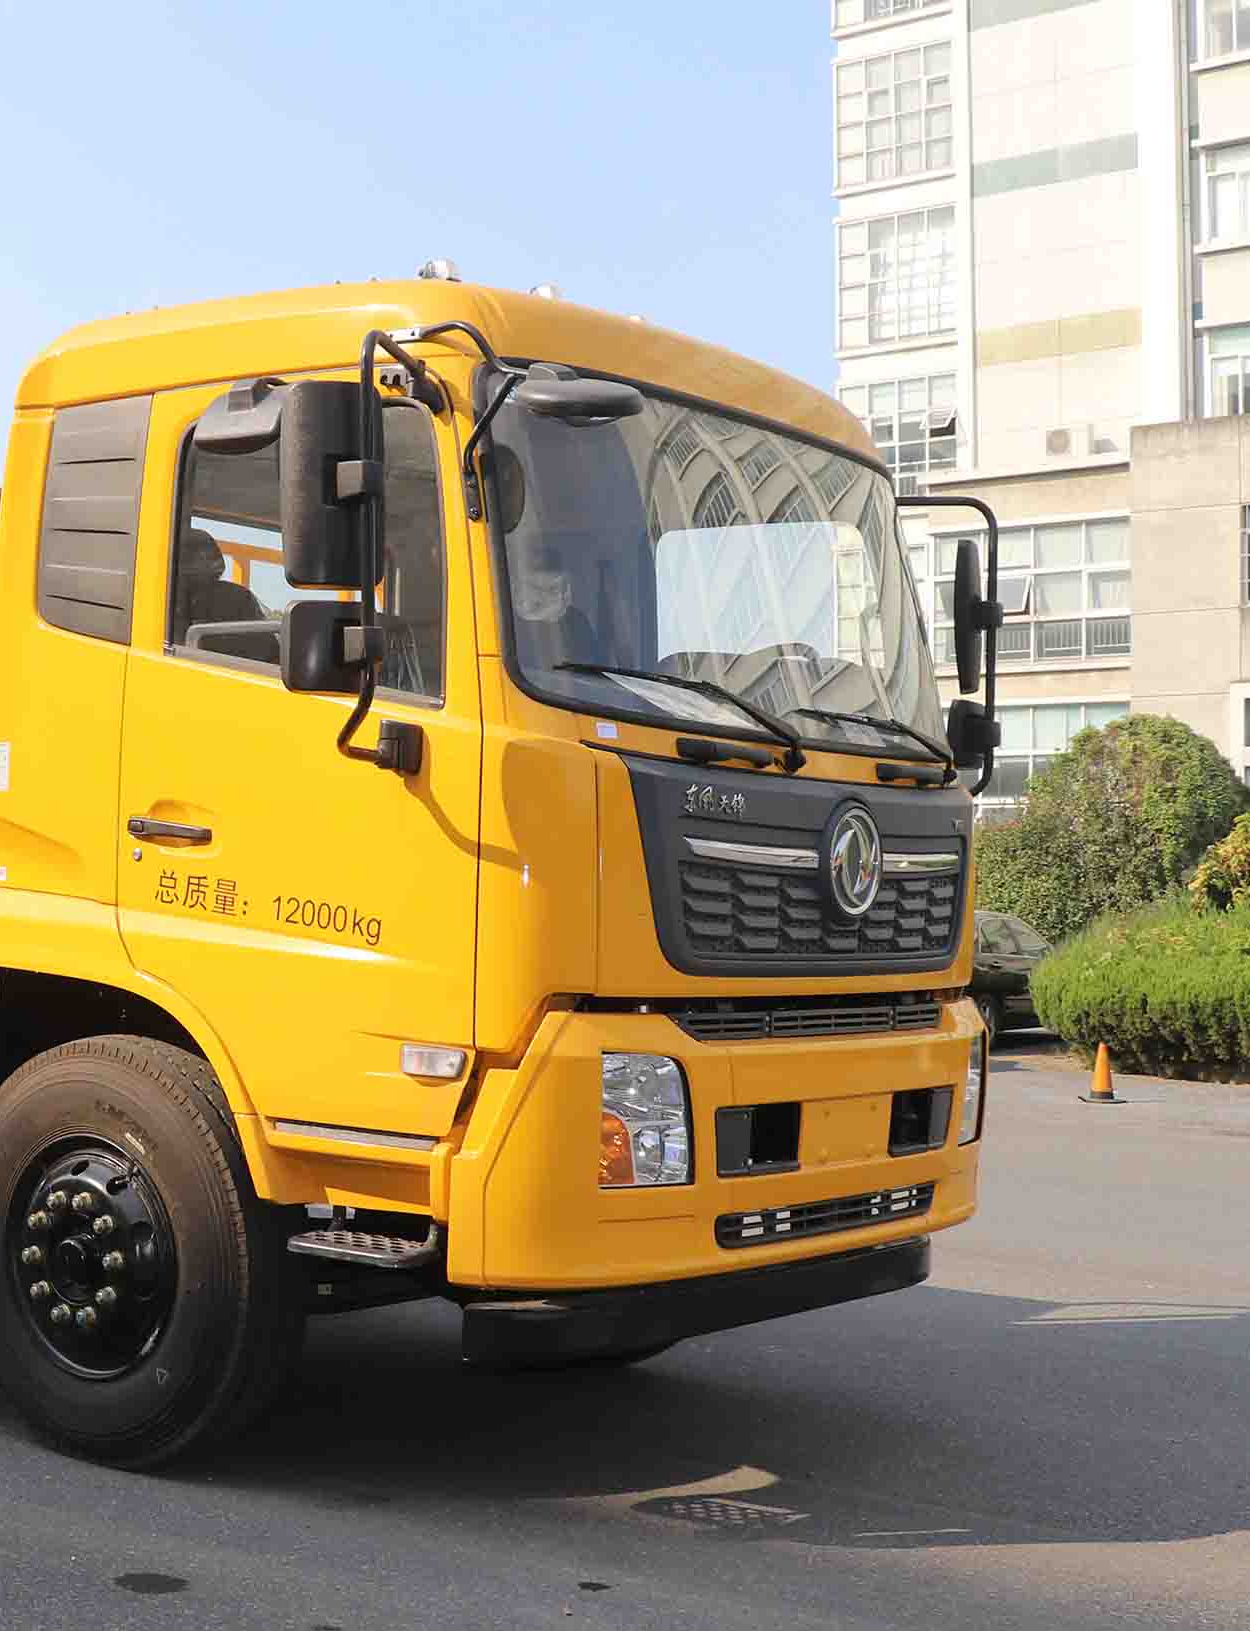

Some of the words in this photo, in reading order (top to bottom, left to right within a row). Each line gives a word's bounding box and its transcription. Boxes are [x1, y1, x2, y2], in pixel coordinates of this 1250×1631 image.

[154, 867, 250, 917] 总质量：
[272, 895, 383, 946] 12000kg
